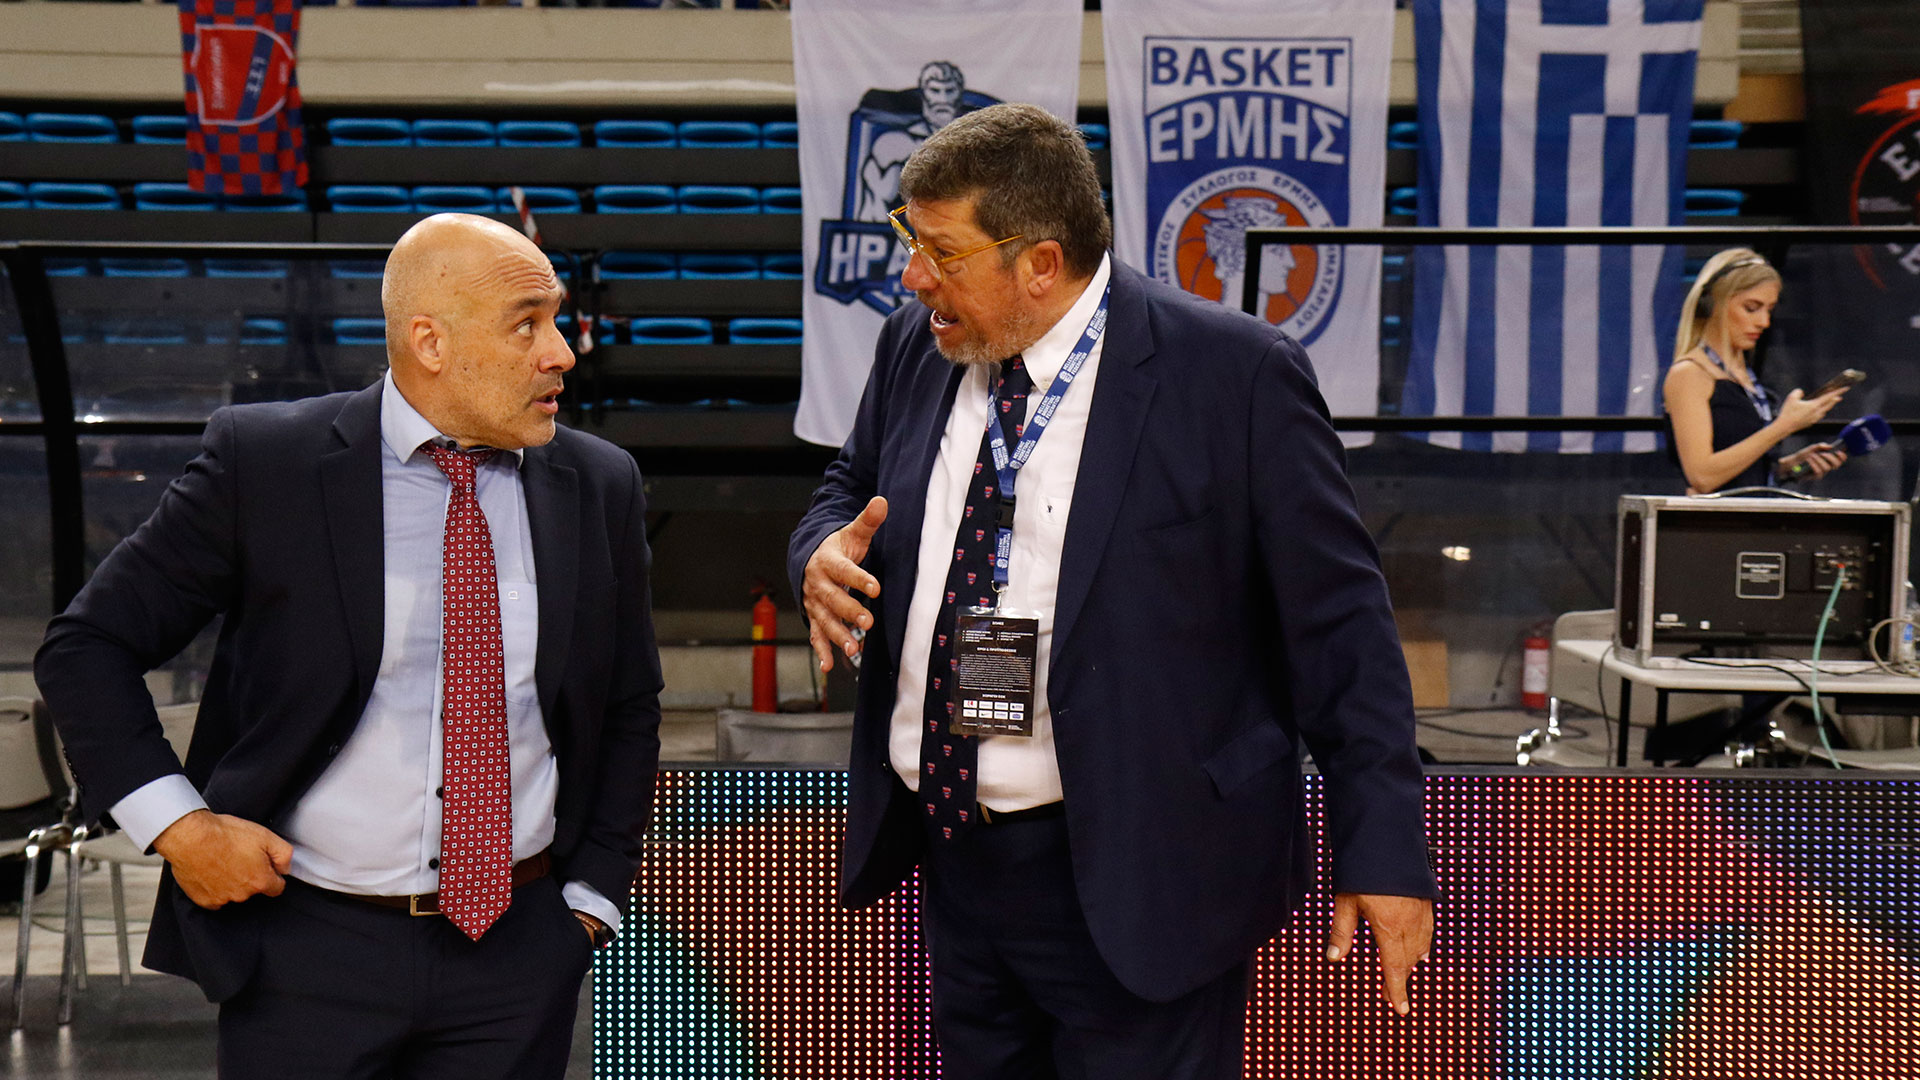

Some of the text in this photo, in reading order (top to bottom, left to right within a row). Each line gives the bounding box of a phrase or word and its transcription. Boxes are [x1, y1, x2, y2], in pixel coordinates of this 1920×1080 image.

[1151, 47, 1345, 86] BASKET
[1151, 96, 1344, 164] ΕΡΜΗΣ
[1181, 171, 1257, 208] ΣΥΛΛΟΓΟΣ
[1273, 175, 1318, 211] ΕΡΜΗΣ
[1296, 222, 1336, 328] ΜΑΤΑΡΙΟΥ
